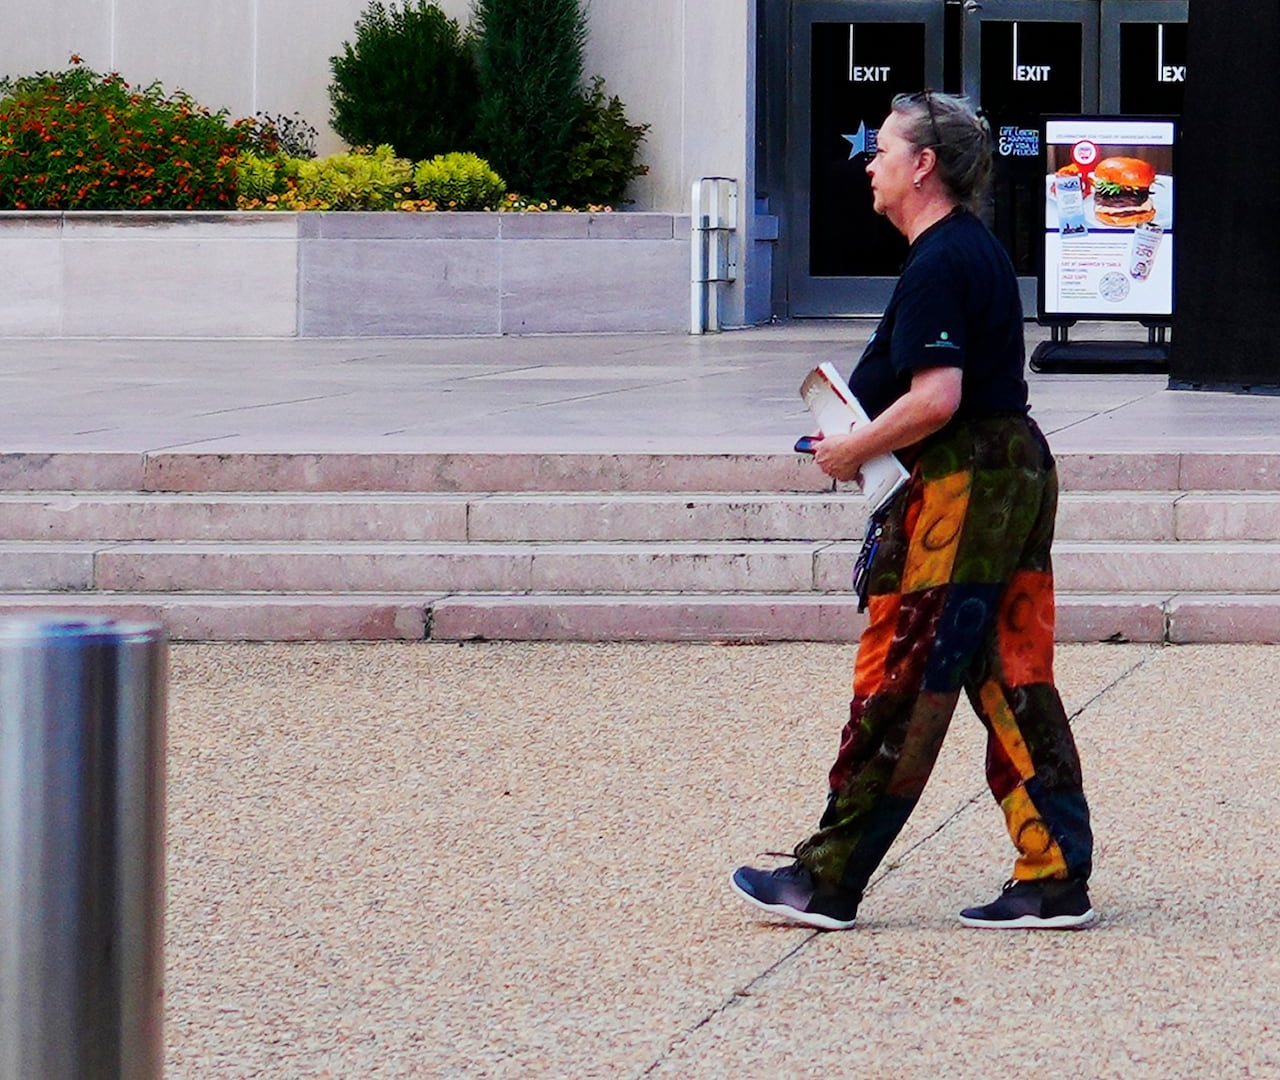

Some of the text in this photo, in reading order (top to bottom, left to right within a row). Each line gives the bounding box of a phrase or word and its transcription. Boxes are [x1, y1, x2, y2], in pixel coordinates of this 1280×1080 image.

[853, 66, 890, 82] EXIT
[1016, 65, 1051, 82] EXIT
[1162, 66, 1187, 82] EX
